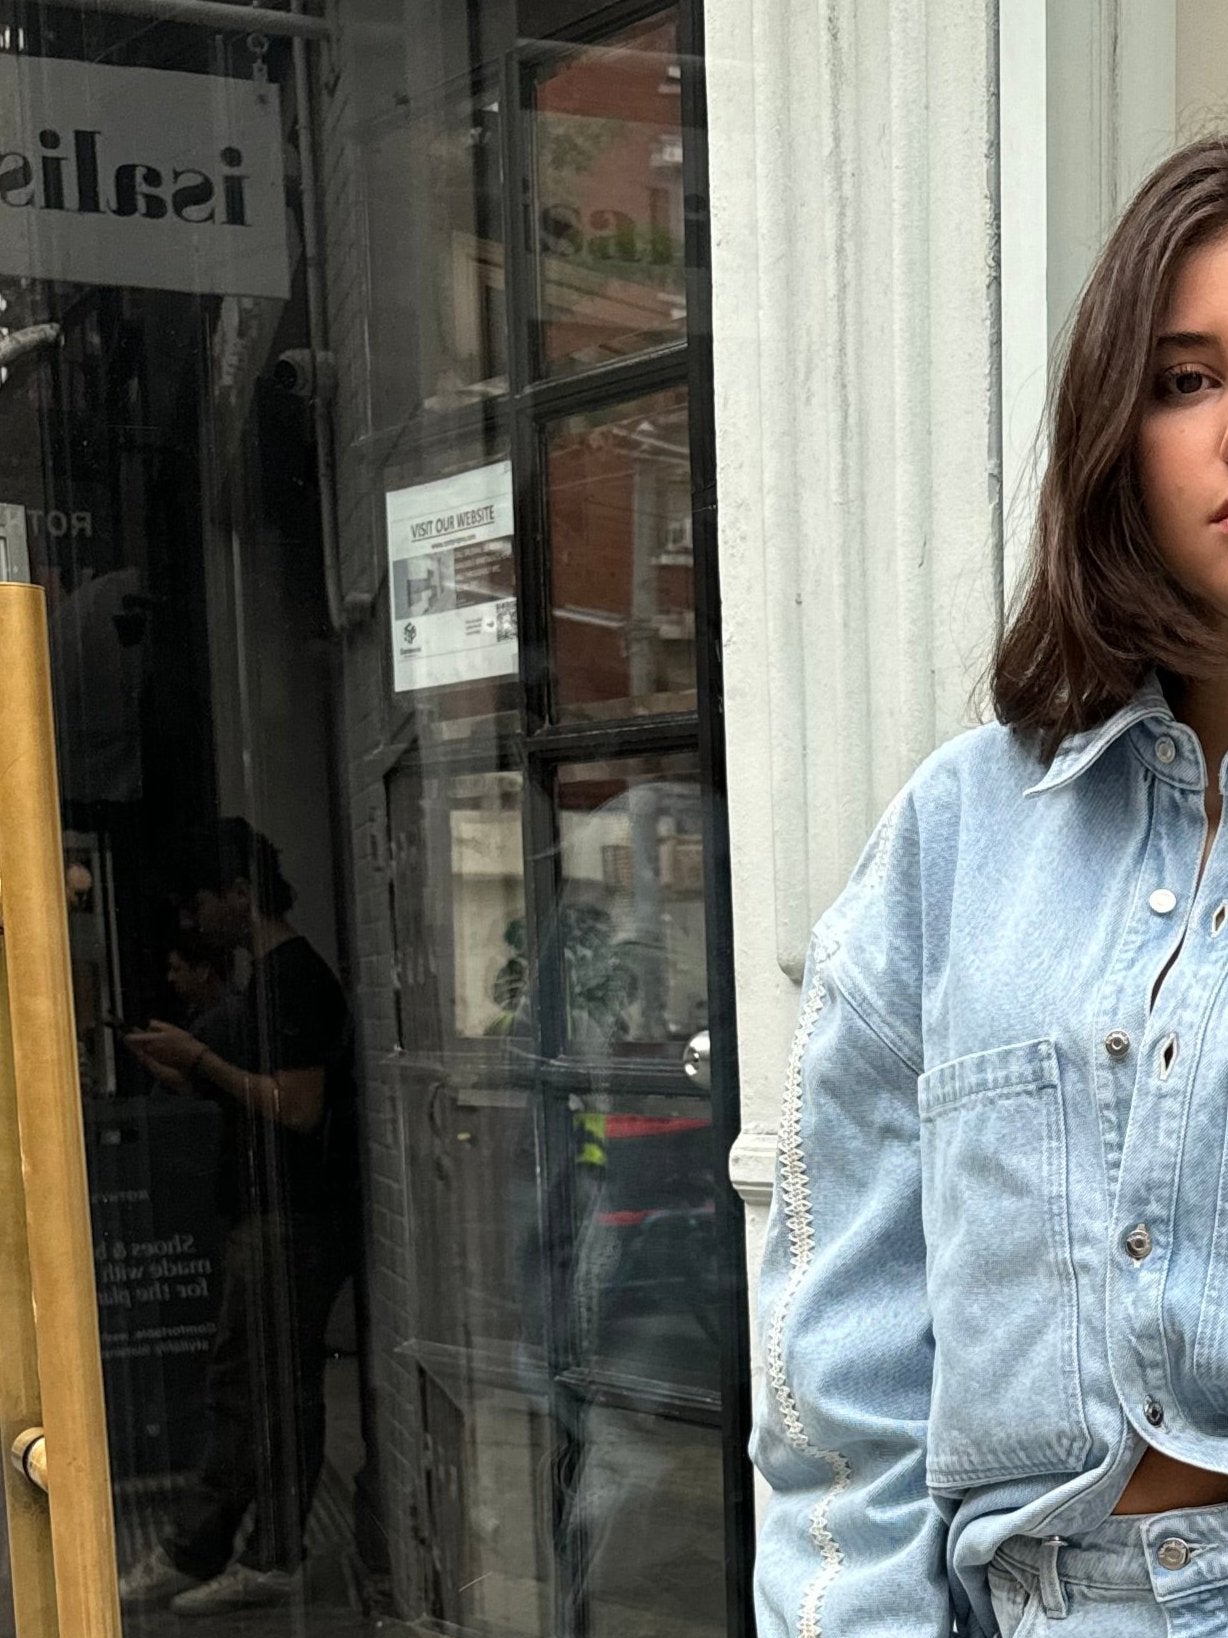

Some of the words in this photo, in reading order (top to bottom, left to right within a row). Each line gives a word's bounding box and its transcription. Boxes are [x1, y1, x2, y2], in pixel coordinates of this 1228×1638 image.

[411, 520, 433, 538] VISIT
[435, 515, 455, 533] OUR
[457, 505, 494, 527] WEBSITE
